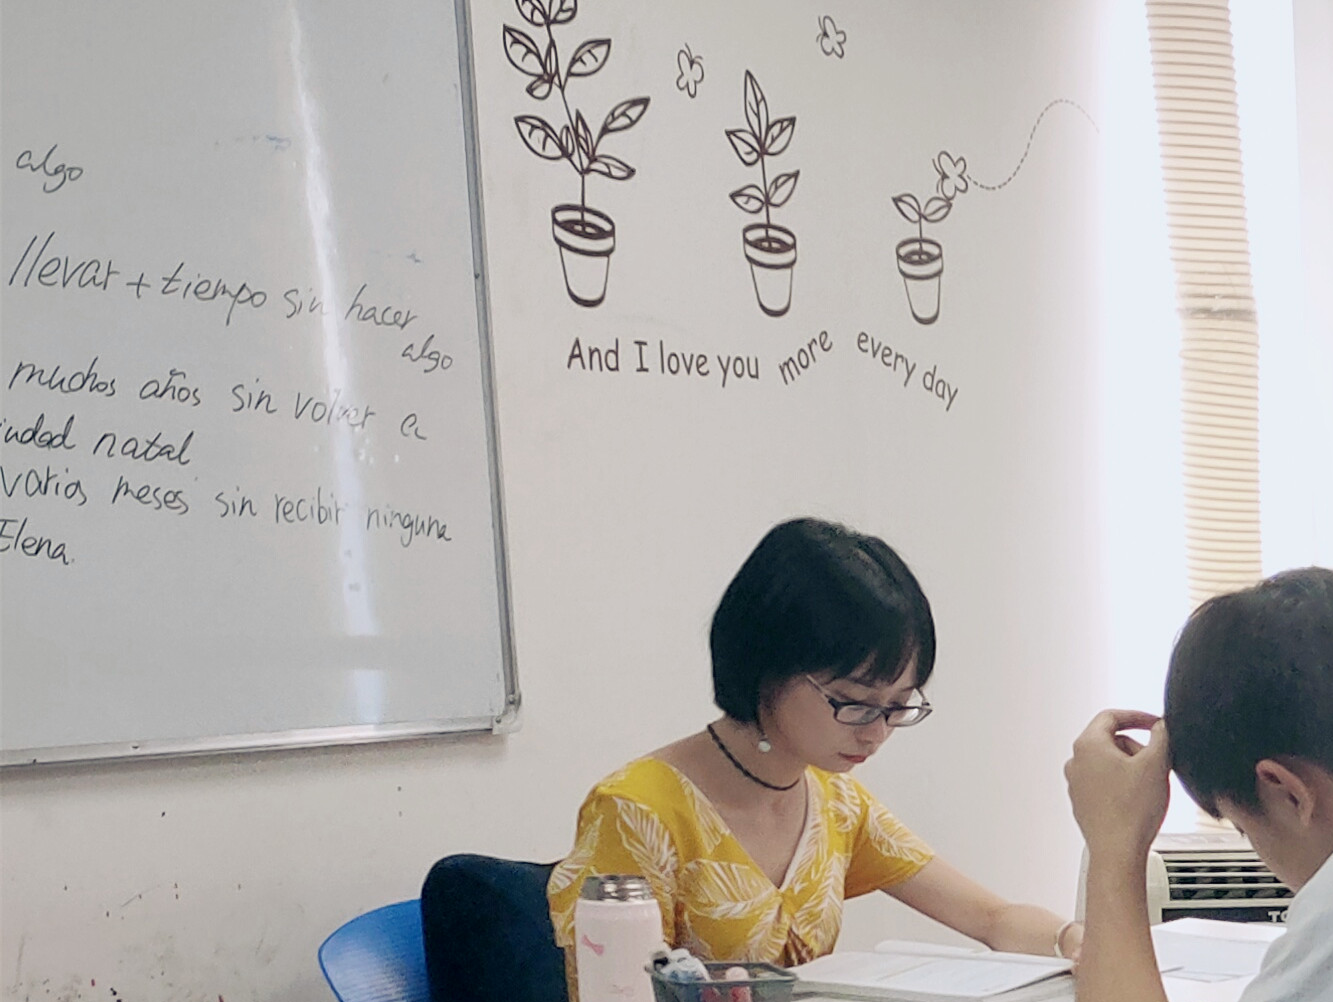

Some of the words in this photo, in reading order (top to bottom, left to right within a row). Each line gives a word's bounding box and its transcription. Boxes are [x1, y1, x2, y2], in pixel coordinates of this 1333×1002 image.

[16, 144, 83, 193] algo
[9, 231, 120, 291] llevar
[161, 261, 267, 327] tiempo
[344, 283, 418, 331] hacer
[401, 333, 453, 374] algo
[567, 337, 620, 372] And
[632, 340, 650, 373] I
[659, 340, 710, 377] love
[716, 353, 761, 389] you
[778, 329, 834, 386] more
[856, 330, 917, 388] every
[922, 365, 960, 412] day
[8, 356, 116, 398] muchos
[139, 368, 201, 407] años
[92, 430, 195, 465] natal
[111, 475, 189, 515] meses
[215, 486, 258, 518] sin
[274, 485, 344, 526] recibir
[365, 505, 452, 547] ninguna
